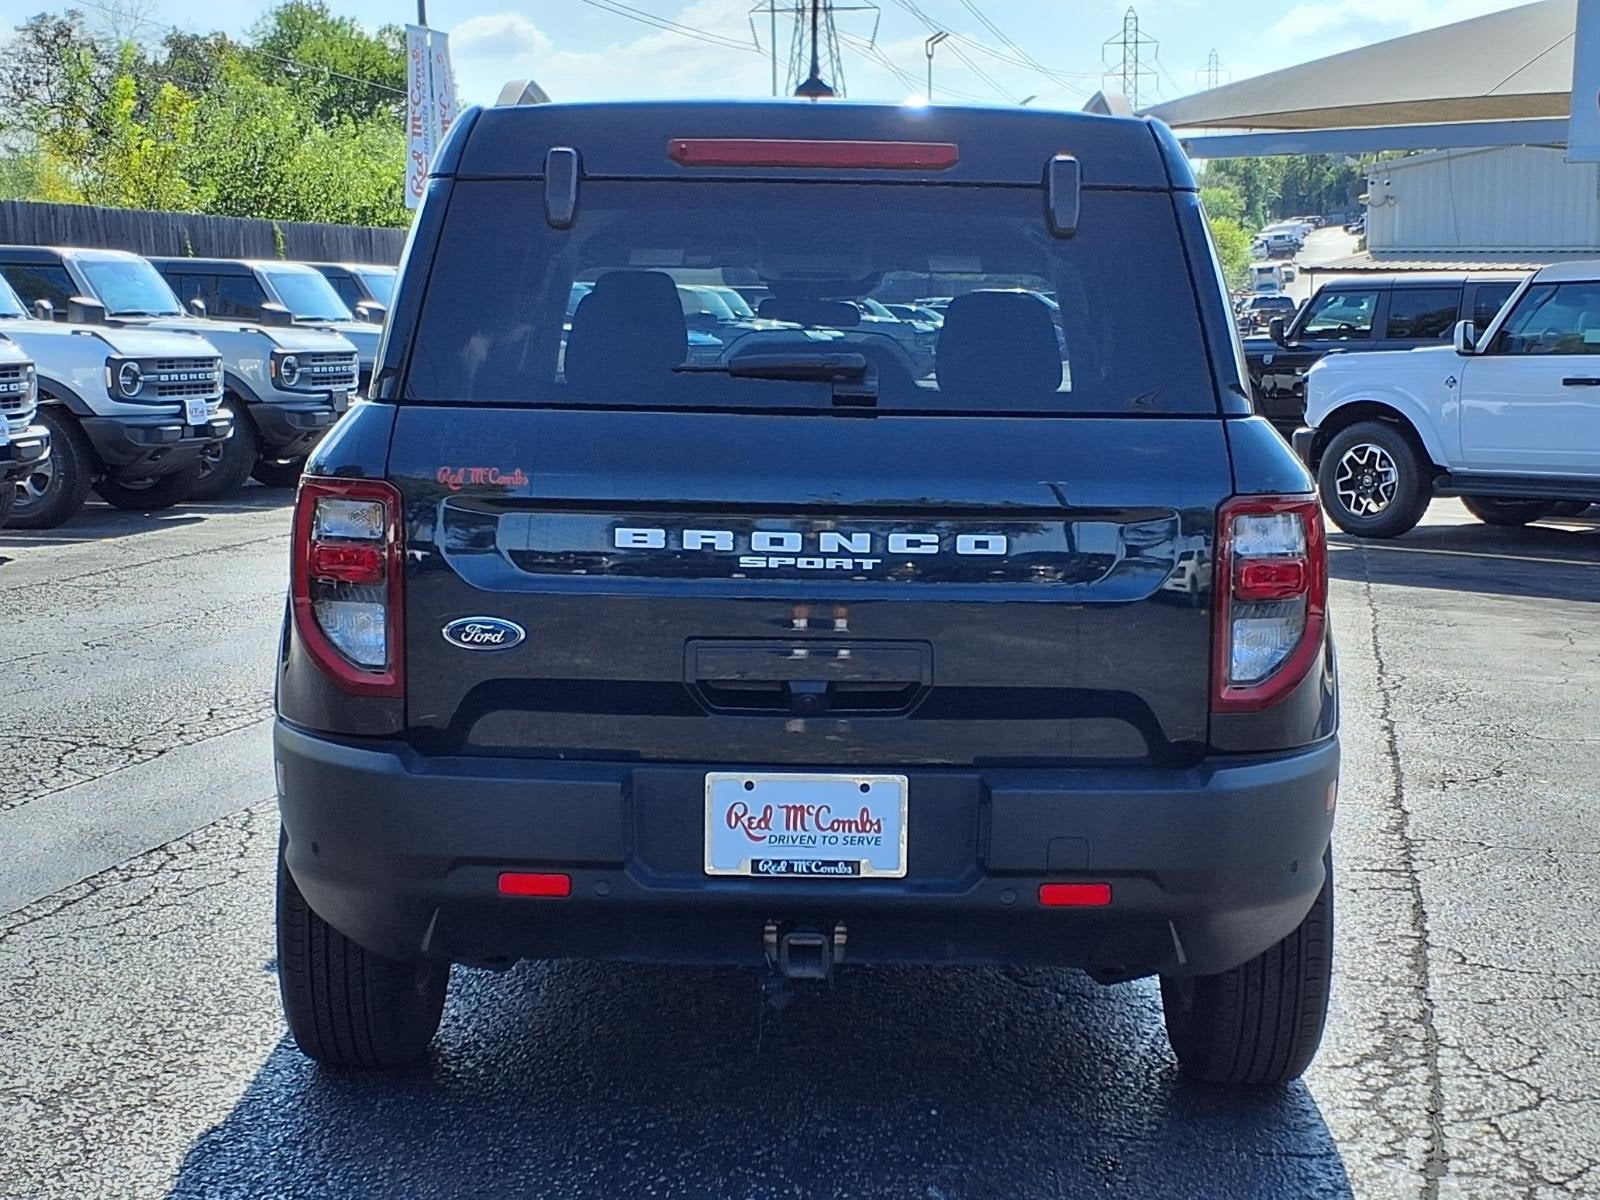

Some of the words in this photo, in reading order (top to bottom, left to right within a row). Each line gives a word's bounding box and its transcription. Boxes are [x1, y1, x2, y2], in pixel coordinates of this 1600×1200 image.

[411, 150, 428, 198] Red
[160, 372, 213, 381] BRONCO
[437, 466, 465, 490] Red
[467, 467, 529, 485] McCombs
[614, 527, 1007, 555] BRONCO
[738, 556, 882, 570] SPORT
[460, 623, 505, 643] Ford
[726, 801, 774, 842] Red
[777, 803, 882, 834] McCombs
[768, 834, 817, 845] DRIVEN
[822, 835, 839, 845] TO
[842, 835, 882, 846] SERVE
[758, 859, 787, 874] Red
[789, 860, 853, 874] McCombs
